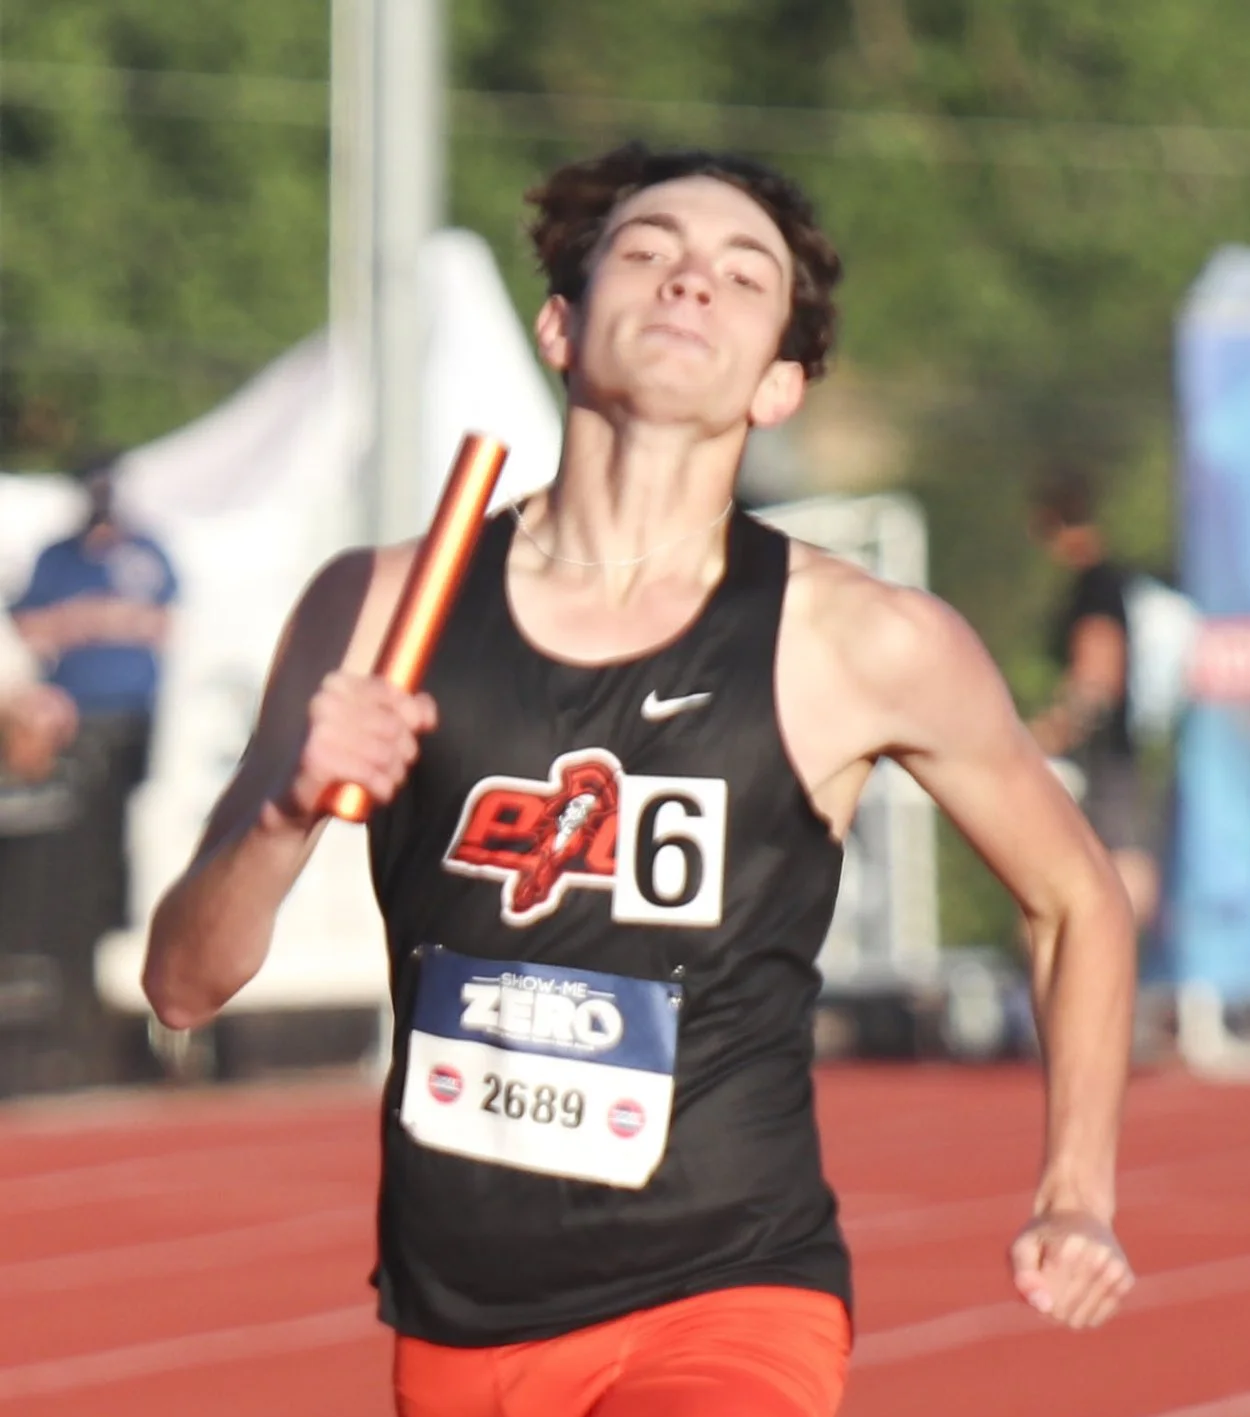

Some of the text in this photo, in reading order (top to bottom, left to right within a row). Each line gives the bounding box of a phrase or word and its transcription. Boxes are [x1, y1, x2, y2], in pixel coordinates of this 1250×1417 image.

[633, 788, 706, 908] 6
[461, 983, 624, 1047] ZERO
[501, 972, 588, 998] SHOW-ME
[480, 1071, 587, 1129] 2689
